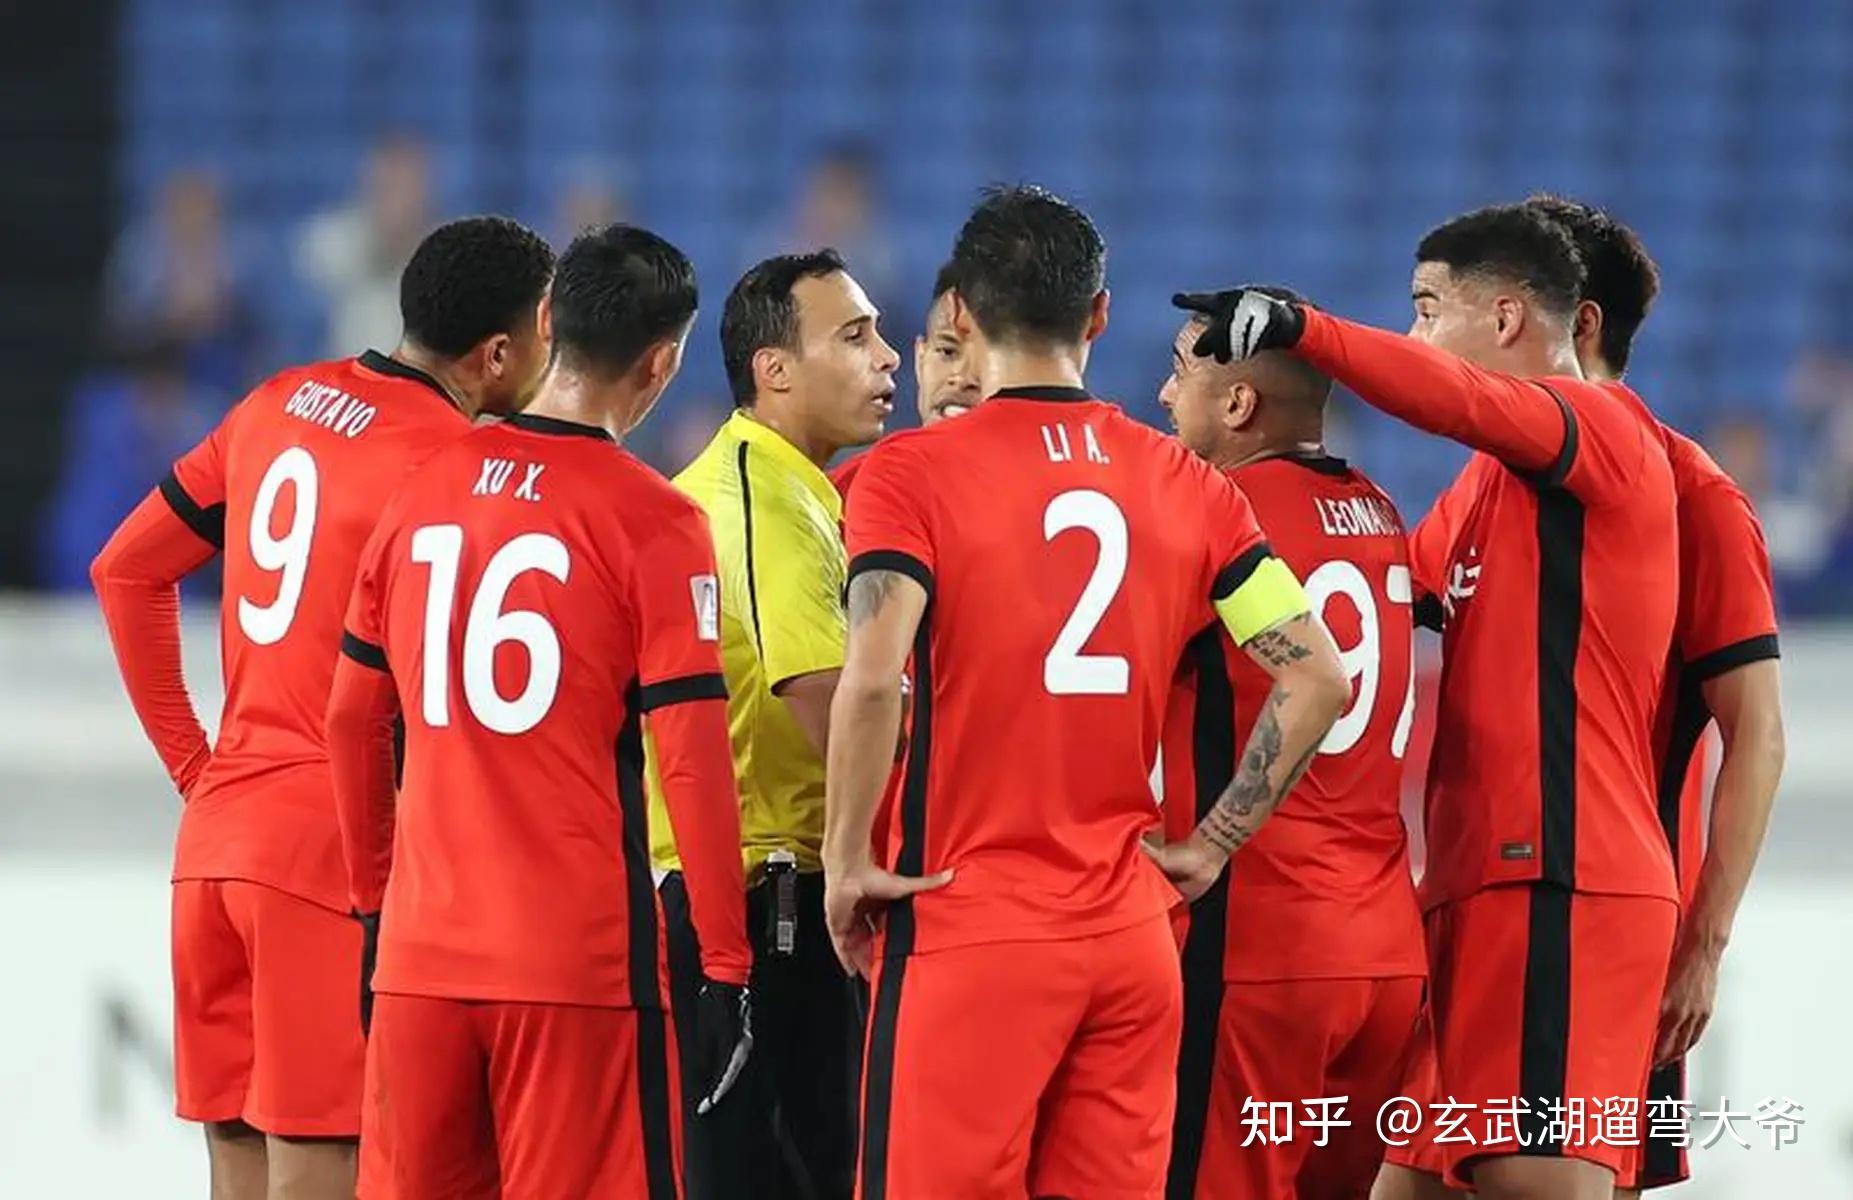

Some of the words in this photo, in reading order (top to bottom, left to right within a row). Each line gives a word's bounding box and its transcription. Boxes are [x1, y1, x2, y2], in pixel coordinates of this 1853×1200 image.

[284, 379, 377, 438] GUSTAVO
[472, 457, 515, 495] XU
[513, 462, 545, 501] X.
[1041, 423, 1072, 462] LI
[1083, 423, 1110, 464] A.
[238, 446, 318, 645] 9
[411, 524, 570, 734] 16
[1043, 489, 1129, 694] 2
[1304, 560, 1414, 758] 97
